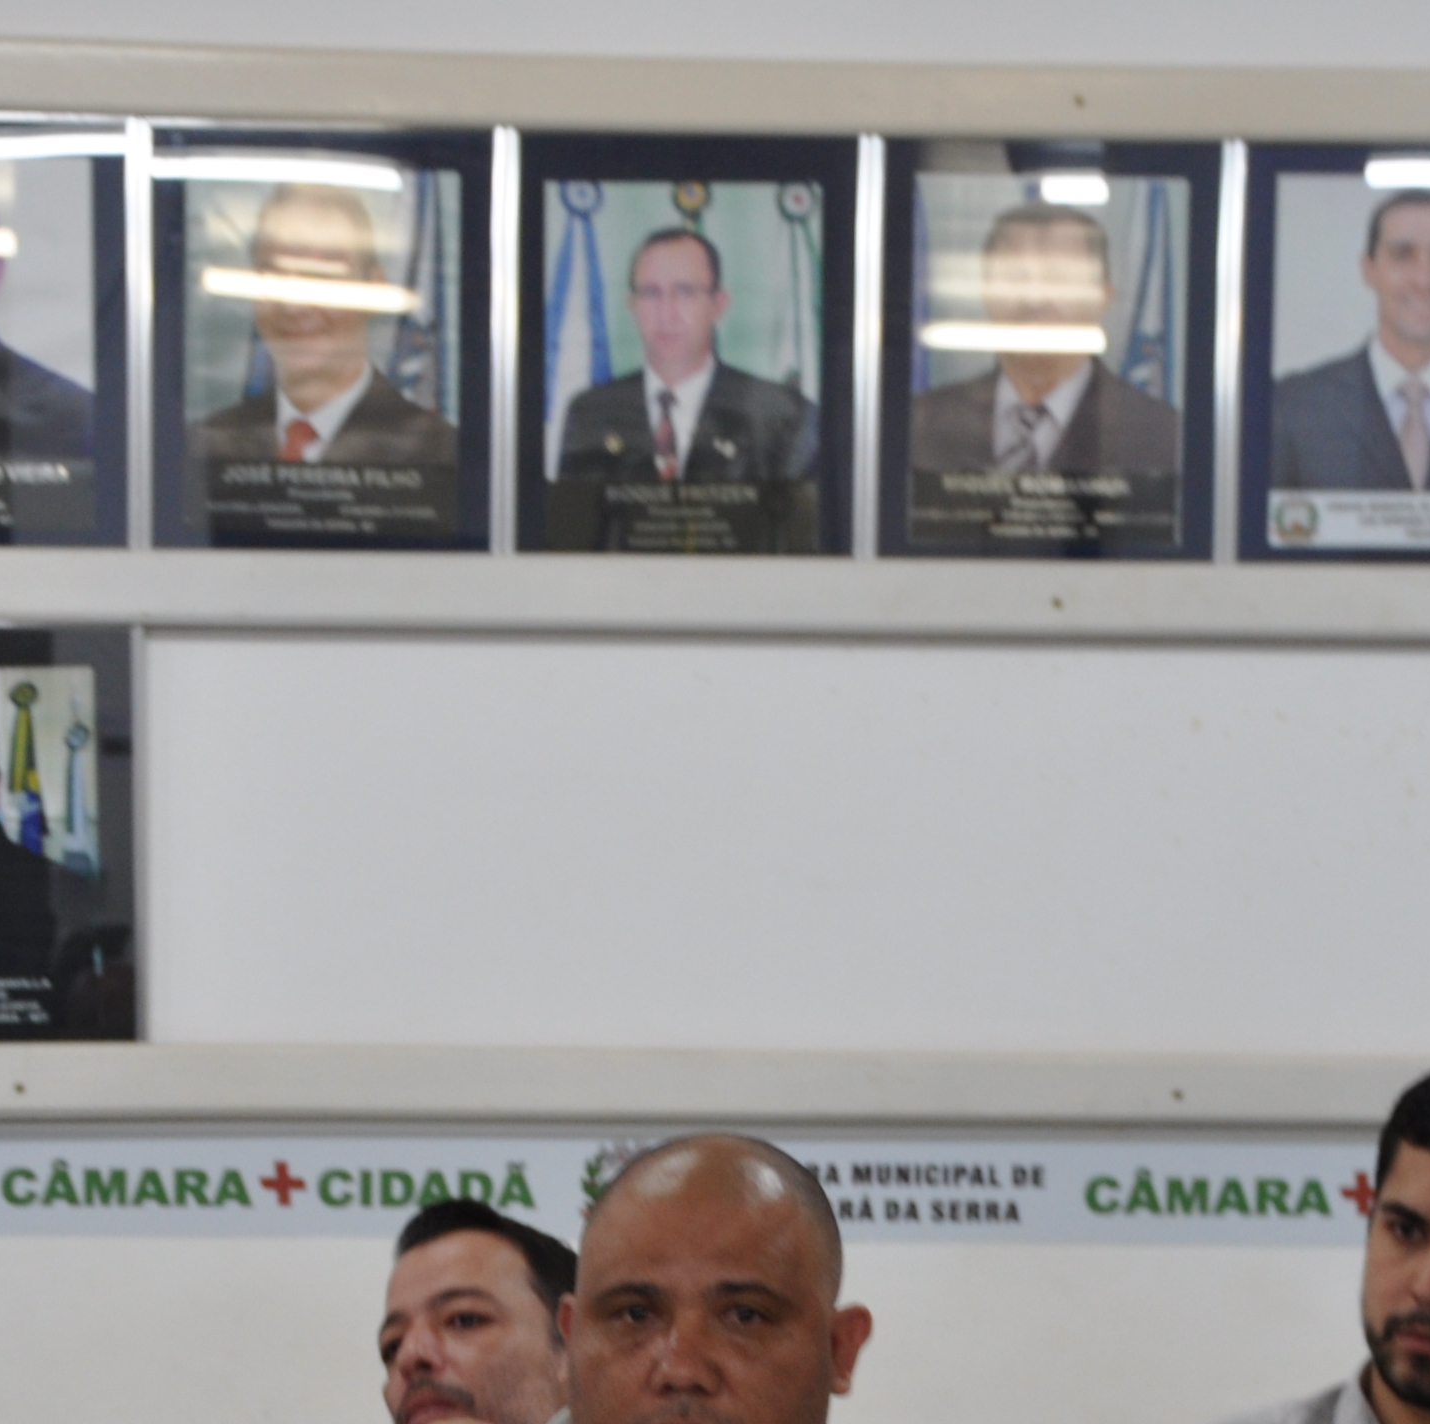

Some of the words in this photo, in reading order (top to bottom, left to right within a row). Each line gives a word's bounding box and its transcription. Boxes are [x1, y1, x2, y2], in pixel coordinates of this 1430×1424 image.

[0, 1157, 253, 1207] CÂMARA
[316, 1160, 536, 1208] CIDADÃ
[851, 1162, 1001, 1188] MUNICIPAL
[1011, 1164, 1046, 1189] DE
[1084, 1165, 1332, 1216] CÂMARA
[884, 1199, 920, 1222] DA
[930, 1199, 1021, 1223] SERRA
